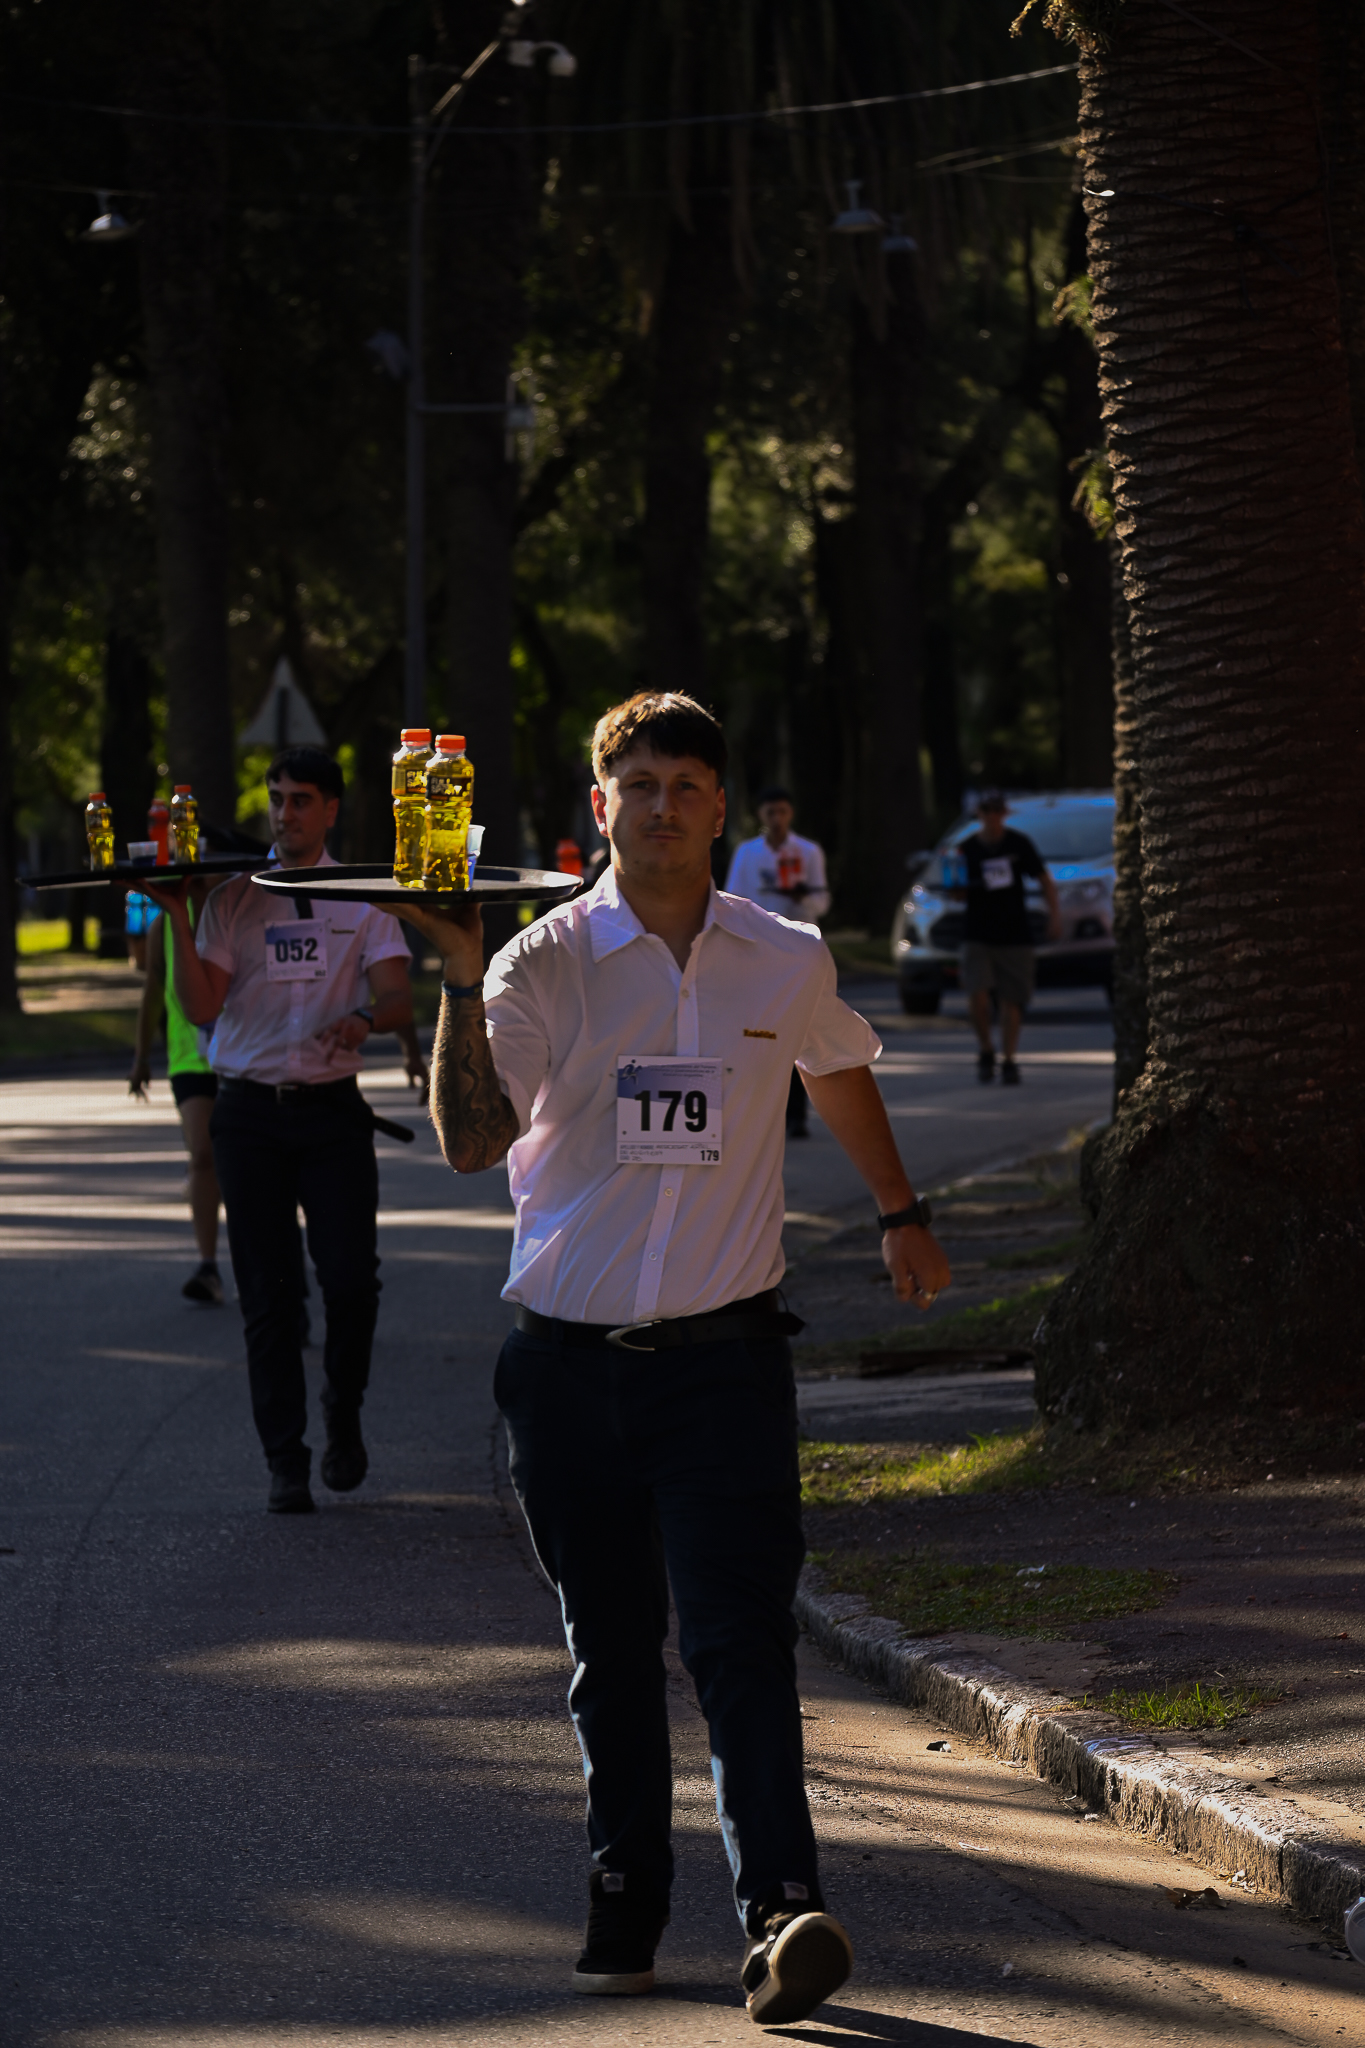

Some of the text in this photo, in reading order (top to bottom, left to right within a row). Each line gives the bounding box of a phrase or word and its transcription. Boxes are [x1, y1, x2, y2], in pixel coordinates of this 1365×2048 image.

[275, 937, 318, 962] 052
[634, 1090, 707, 1132] 179
[700, 1150, 720, 1161] 179
